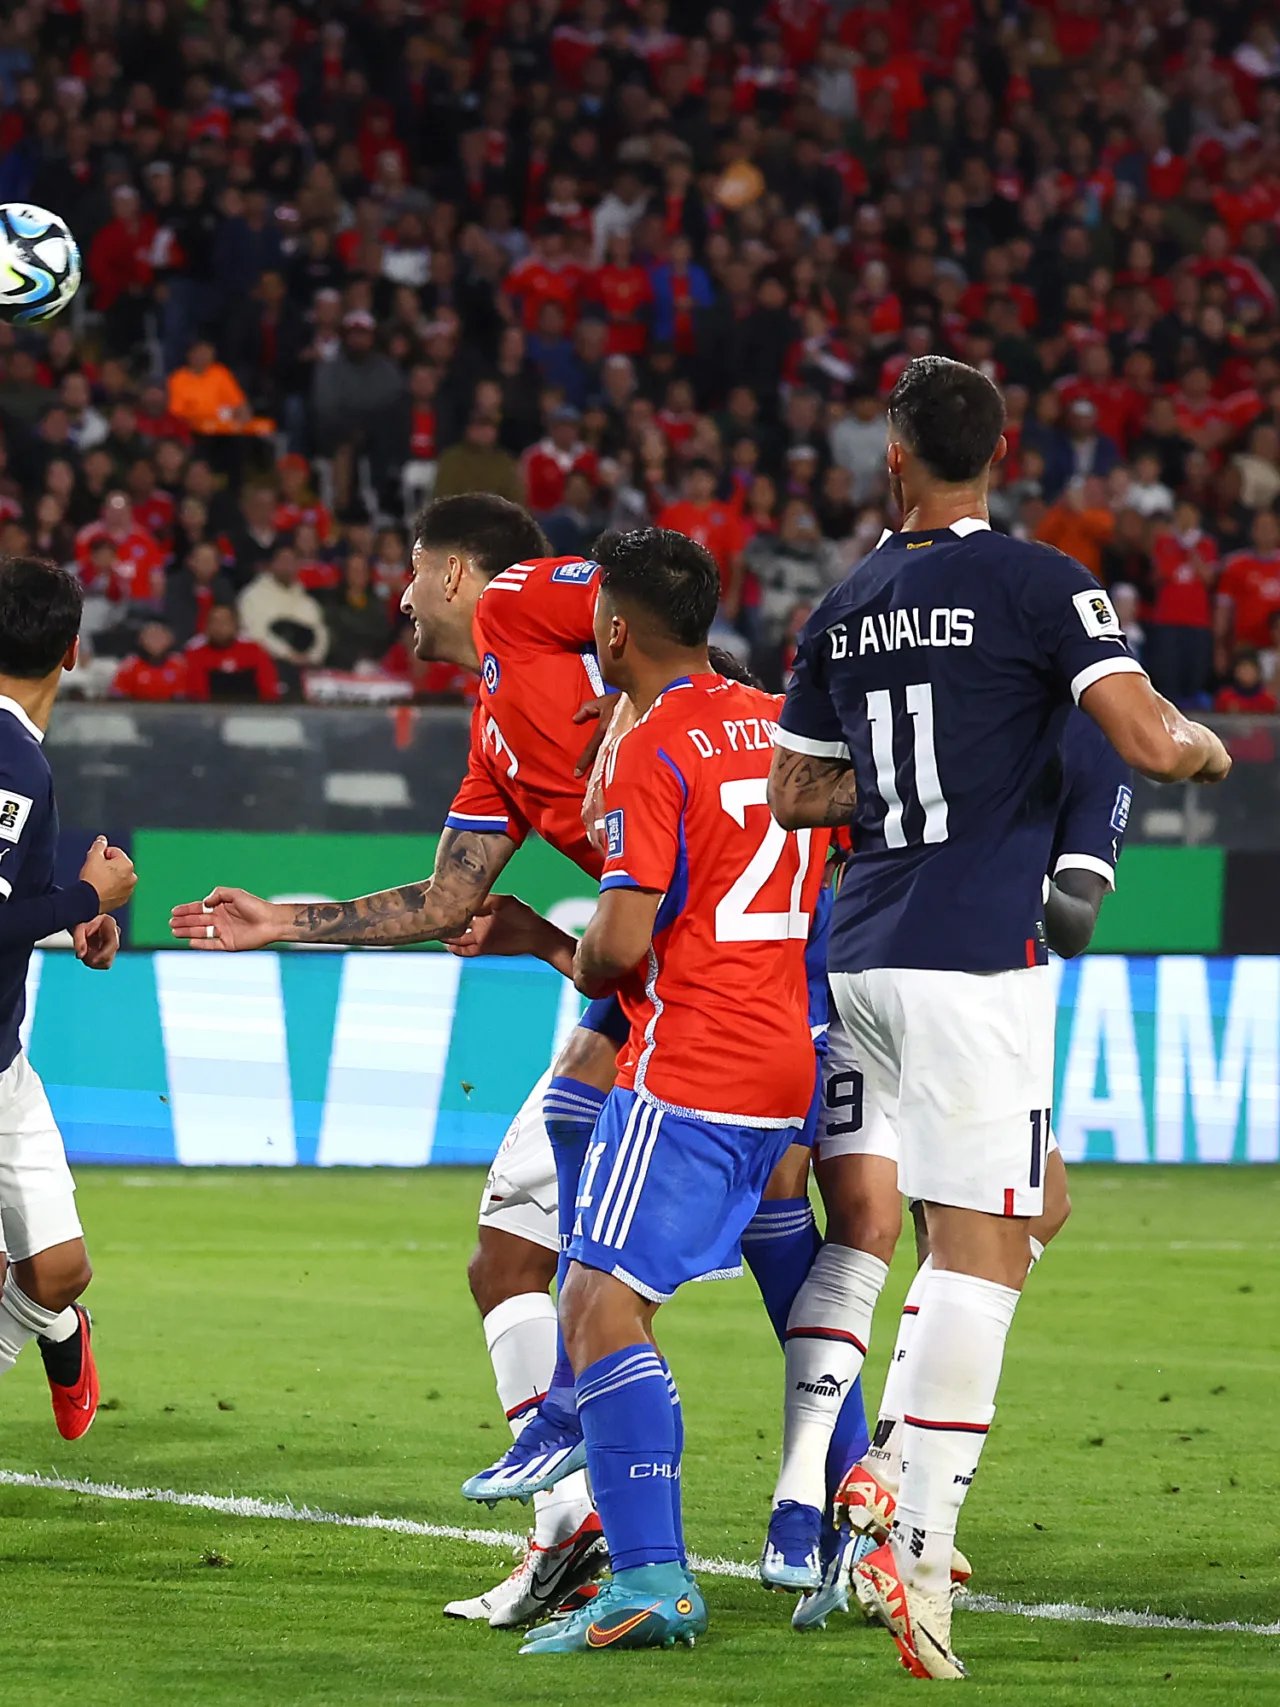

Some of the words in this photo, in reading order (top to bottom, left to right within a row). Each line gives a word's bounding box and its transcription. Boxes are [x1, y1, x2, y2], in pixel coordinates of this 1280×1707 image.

[826, 623, 853, 660] G.
[859, 608, 975, 656] AVALOS
[687, 728, 722, 758] D.
[866, 683, 949, 849] 11
[715, 778, 811, 942] 21
[1058, 955, 1280, 1163] AM
[826, 1070, 864, 1136] 9
[575, 1141, 607, 1208] 1
[796, 1381, 837, 1397] PUMA
[868, 1448, 891, 1461] DER
